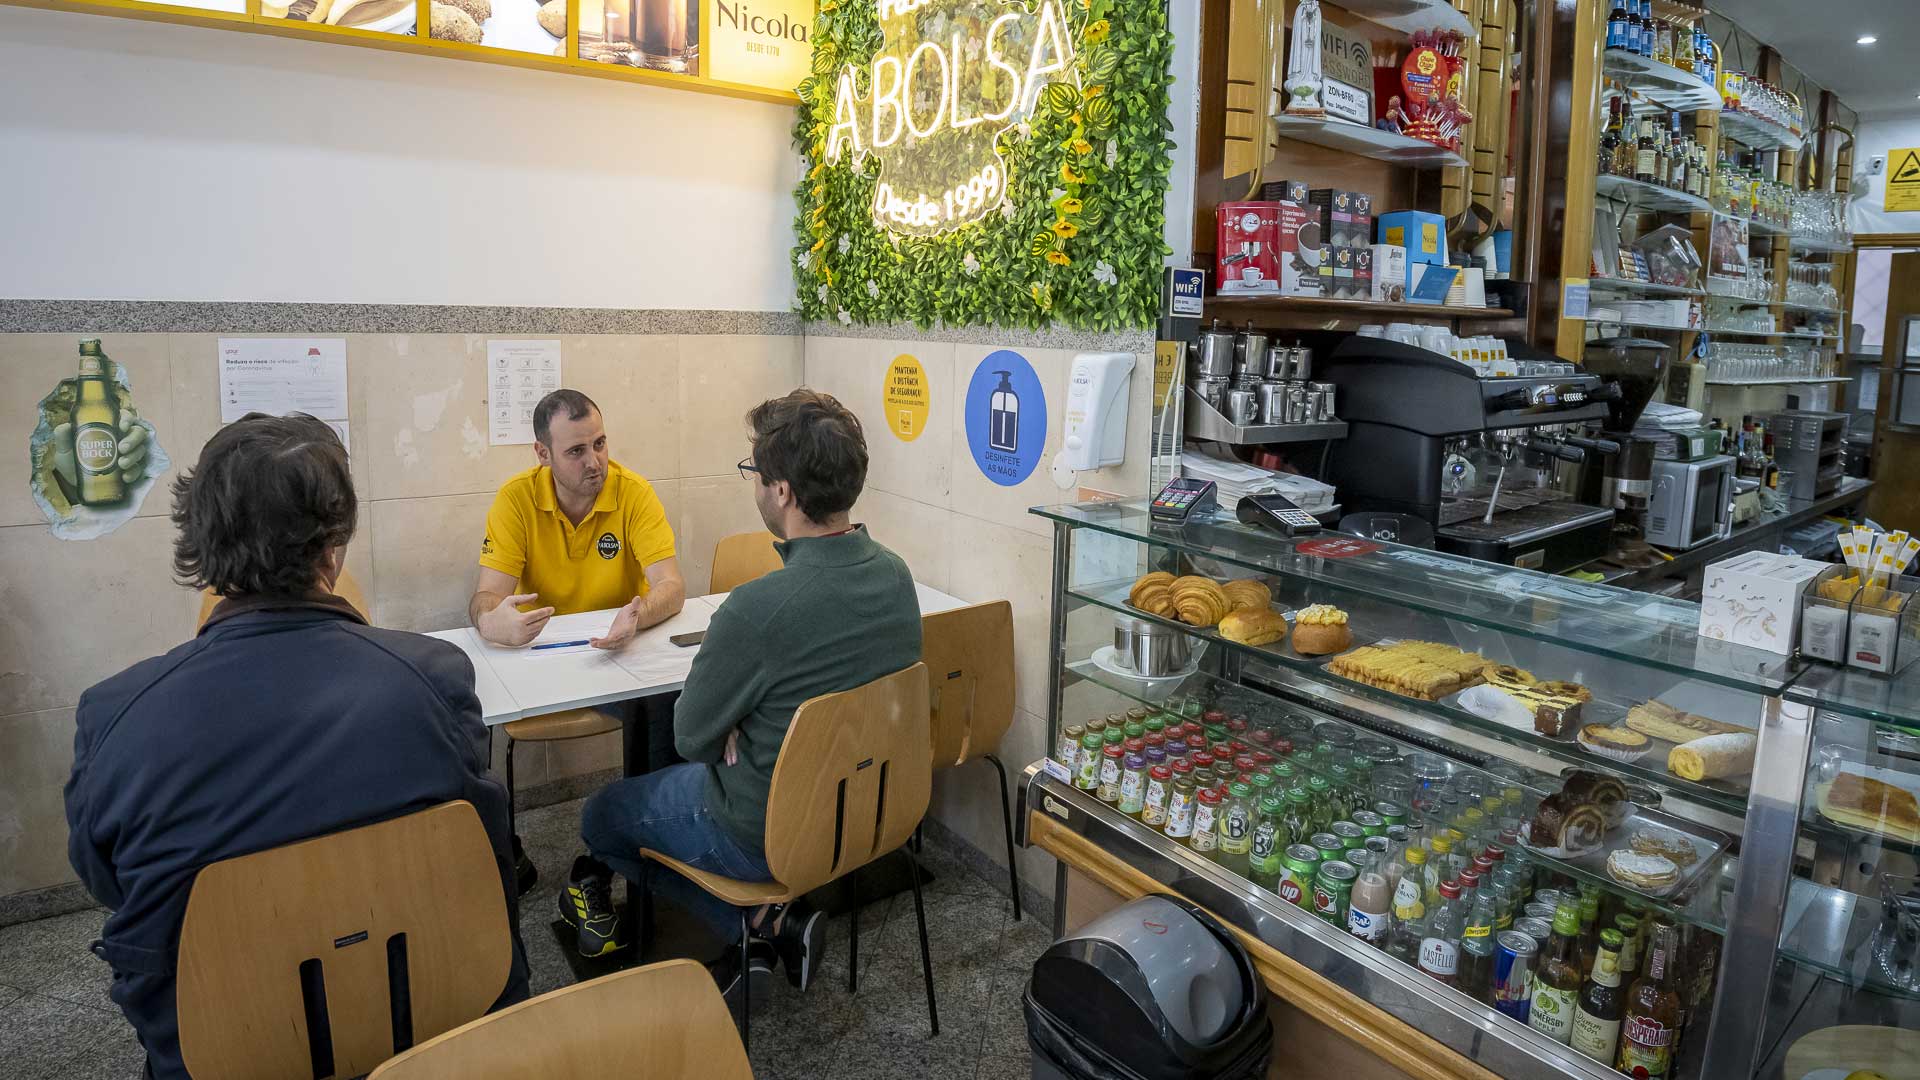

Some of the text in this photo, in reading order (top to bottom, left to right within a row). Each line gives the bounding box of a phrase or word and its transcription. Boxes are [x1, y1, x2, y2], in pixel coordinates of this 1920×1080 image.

[717, 0, 807, 43] Nicola
[872, 0, 1082, 148] BOLSA
[876, 164, 999, 226] Desde 1999
[894, 365, 918, 375] MANTENHA
[79, 440, 113, 450] SUPER
[82, 449, 113, 458] BOCK
[985, 451, 1021, 467] DESINFETE
[987, 463, 997, 473] AS
[1374, 529, 1396, 540] NOS
[1423, 947, 1454, 968] CASTELLO
